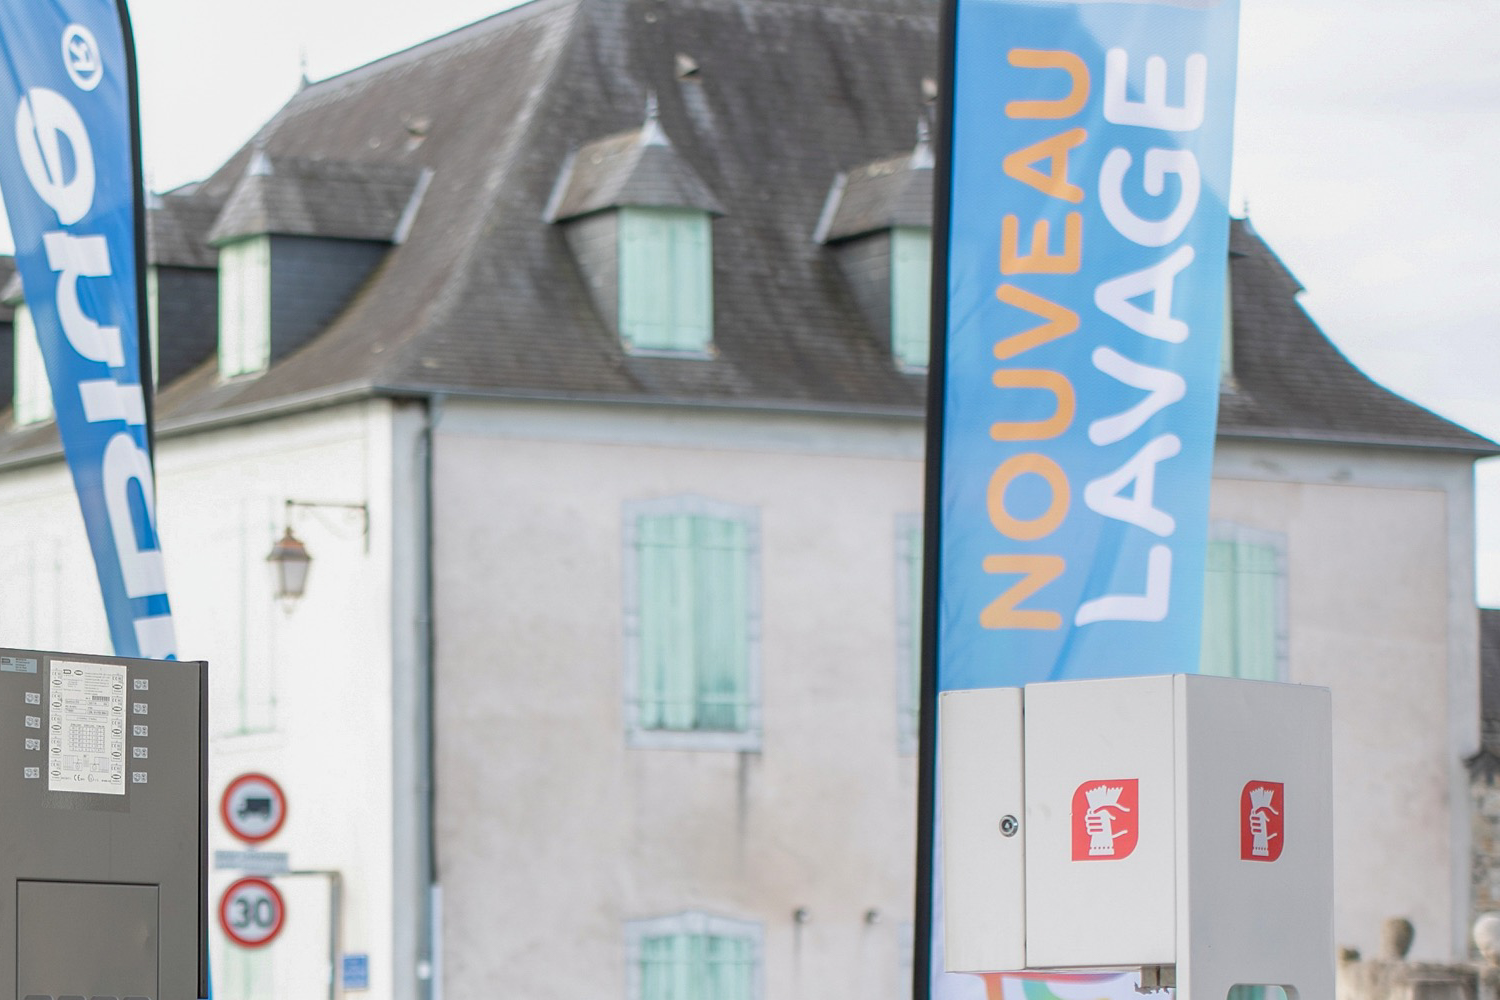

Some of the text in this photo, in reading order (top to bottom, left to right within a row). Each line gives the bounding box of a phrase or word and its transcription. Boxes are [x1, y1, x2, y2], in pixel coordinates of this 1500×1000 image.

[980, 48, 1091, 631] NOUVEAU
[1075, 48, 1208, 627] LAVAGE
[232, 898, 274, 929] 30
